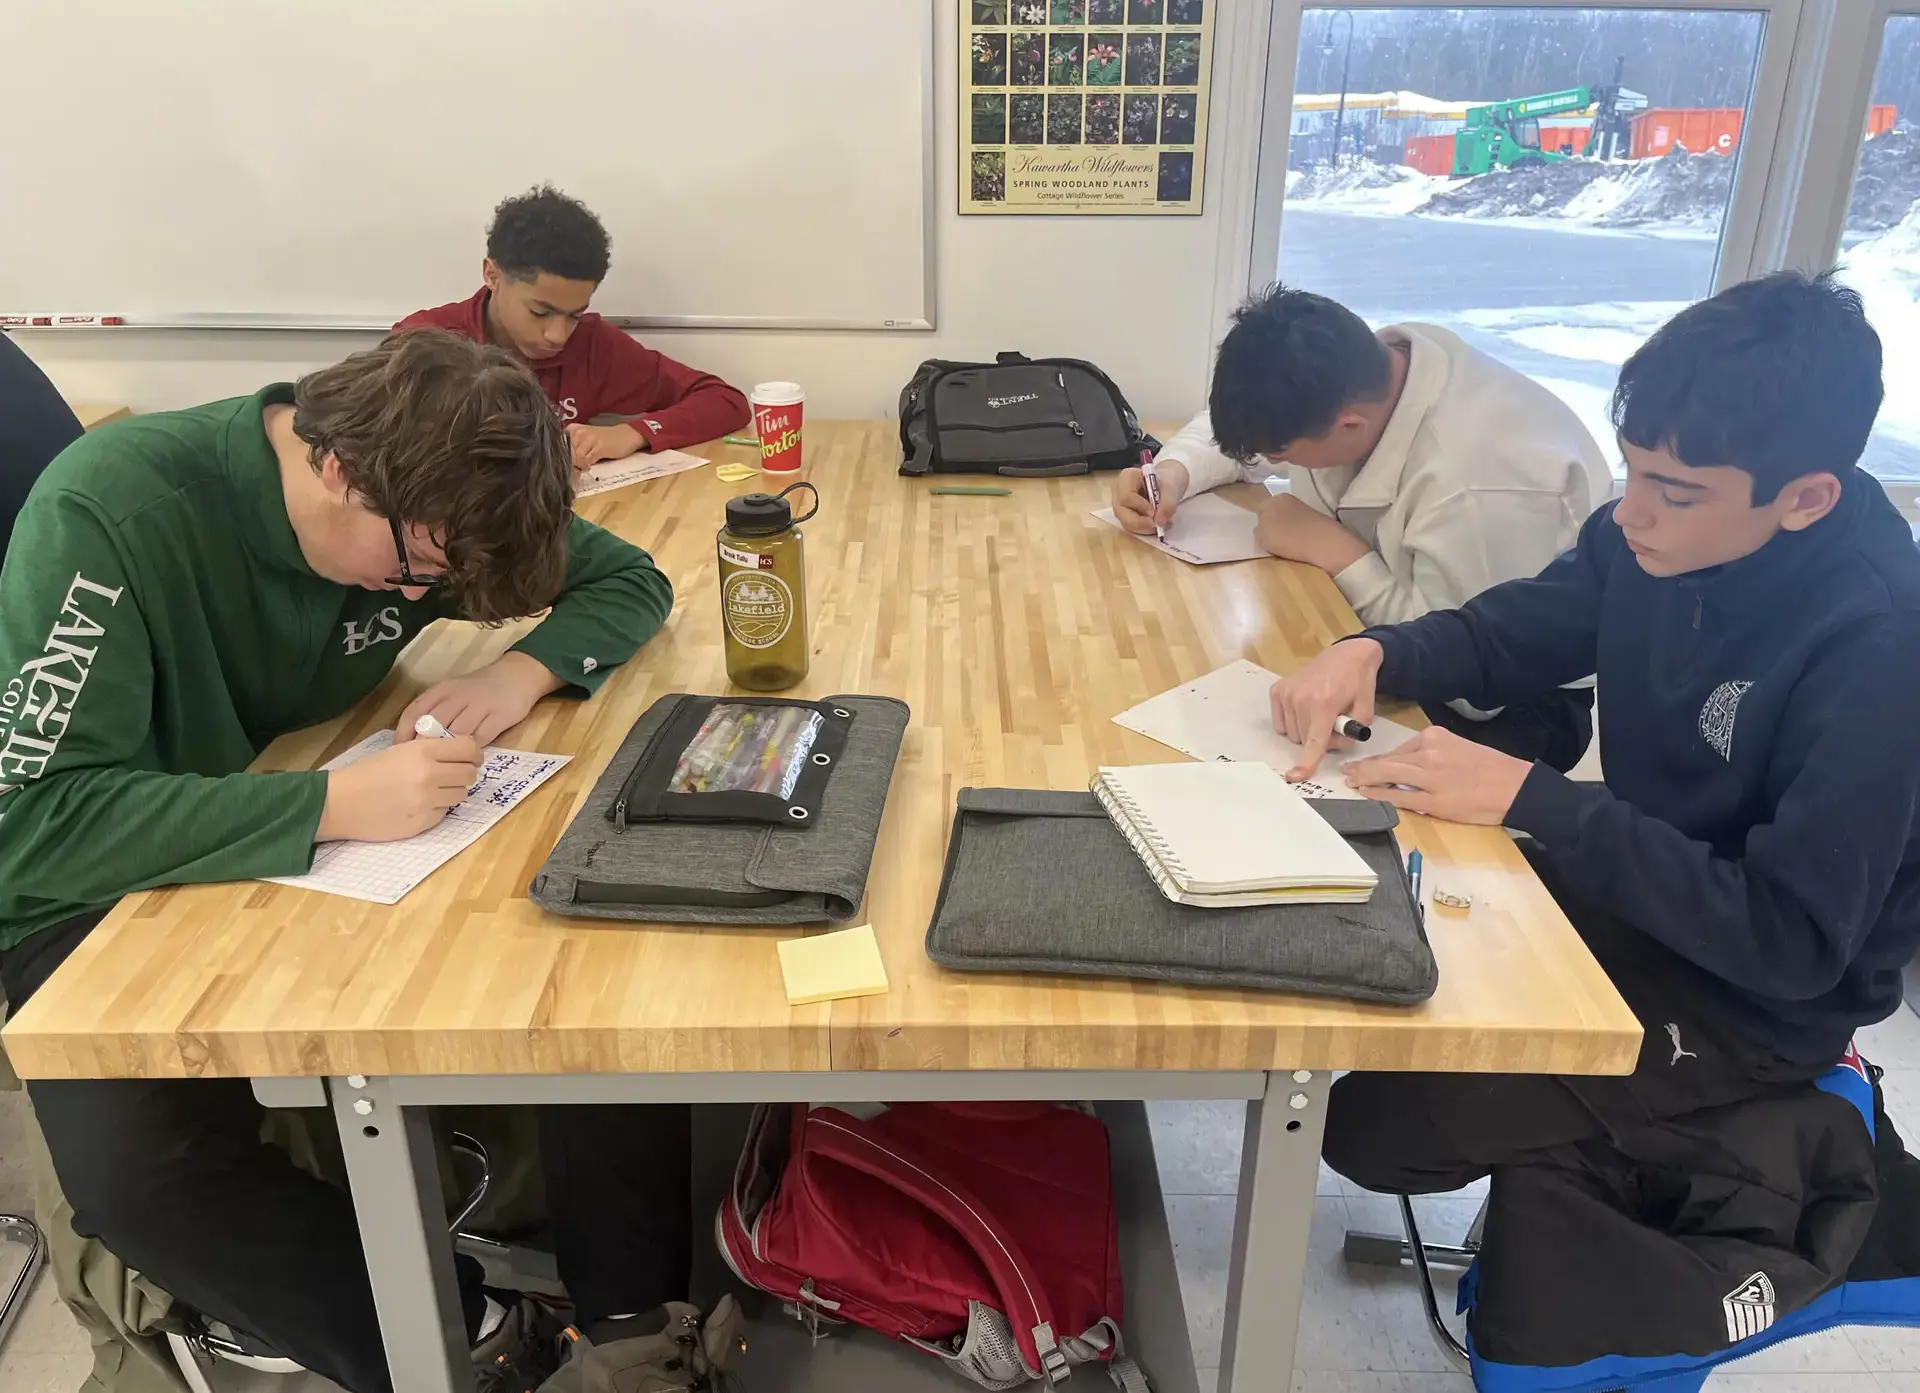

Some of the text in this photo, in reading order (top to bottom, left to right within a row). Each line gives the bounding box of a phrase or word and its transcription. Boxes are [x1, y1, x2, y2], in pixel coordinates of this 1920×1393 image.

[1012, 153, 1154, 177] Kawartha Wildflowers
[1013, 180, 1149, 188] SPRING WOODLAND PLANTS
[1037, 192, 1124, 200] Cottage Wildflower Series
[756, 408, 790, 434] Tim
[728, 601, 785, 615] lakefield
[758, 632, 779, 644] SCHOOL
